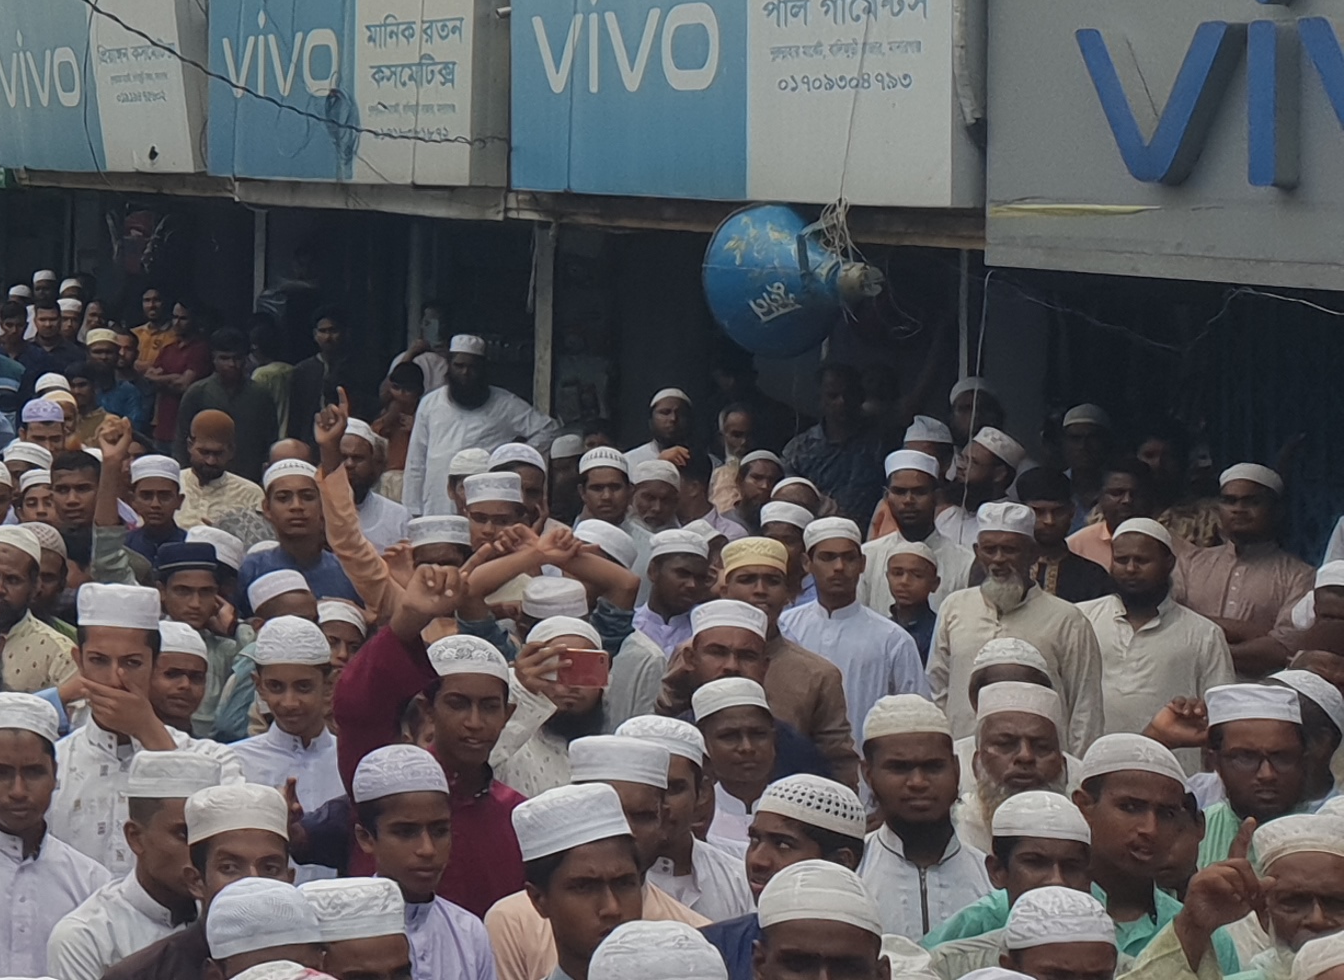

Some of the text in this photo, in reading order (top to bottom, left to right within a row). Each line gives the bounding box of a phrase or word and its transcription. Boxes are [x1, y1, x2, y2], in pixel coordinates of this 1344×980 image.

[365, 14, 464, 49] মানিক রতন
[222, 8, 339, 99] vivo
[369, 54, 457, 89] কসমেটিক্স
